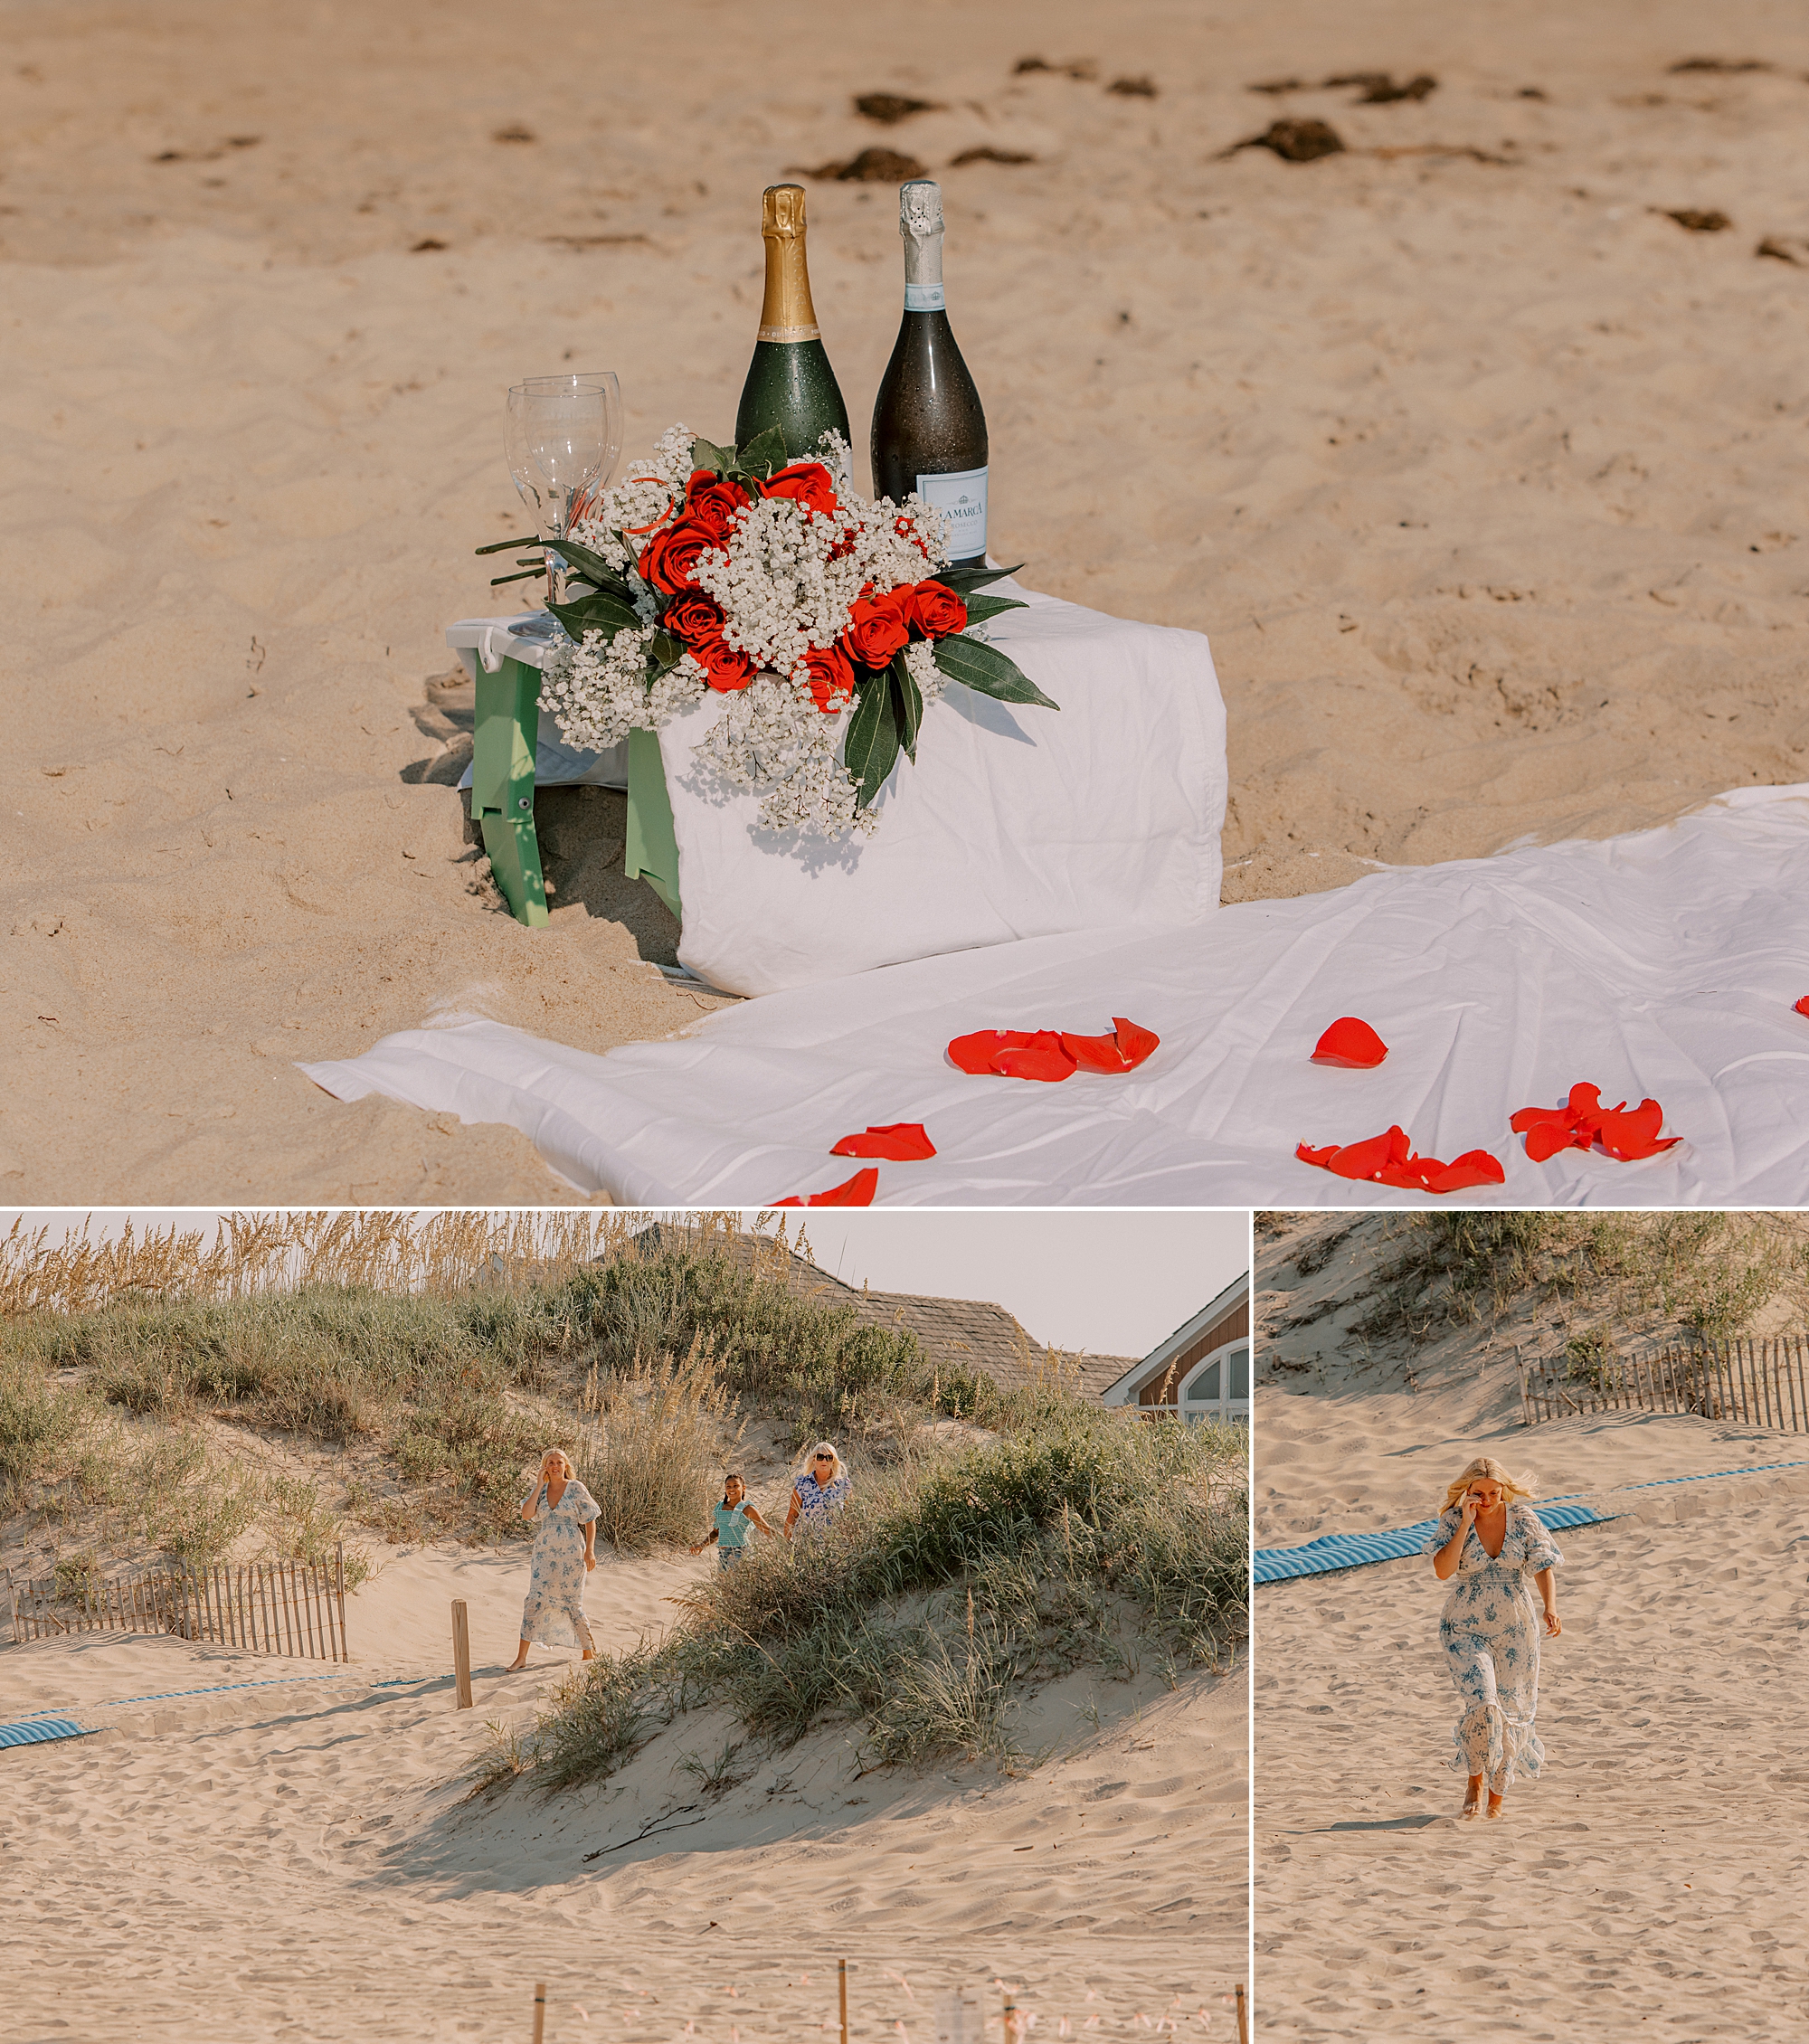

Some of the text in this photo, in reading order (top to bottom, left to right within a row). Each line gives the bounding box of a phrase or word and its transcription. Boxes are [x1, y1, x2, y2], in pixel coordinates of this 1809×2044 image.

[793, 244, 807, 306] DECOY
[953, 502, 982, 518] MARCA
[951, 519, 978, 529] ROSECCO
